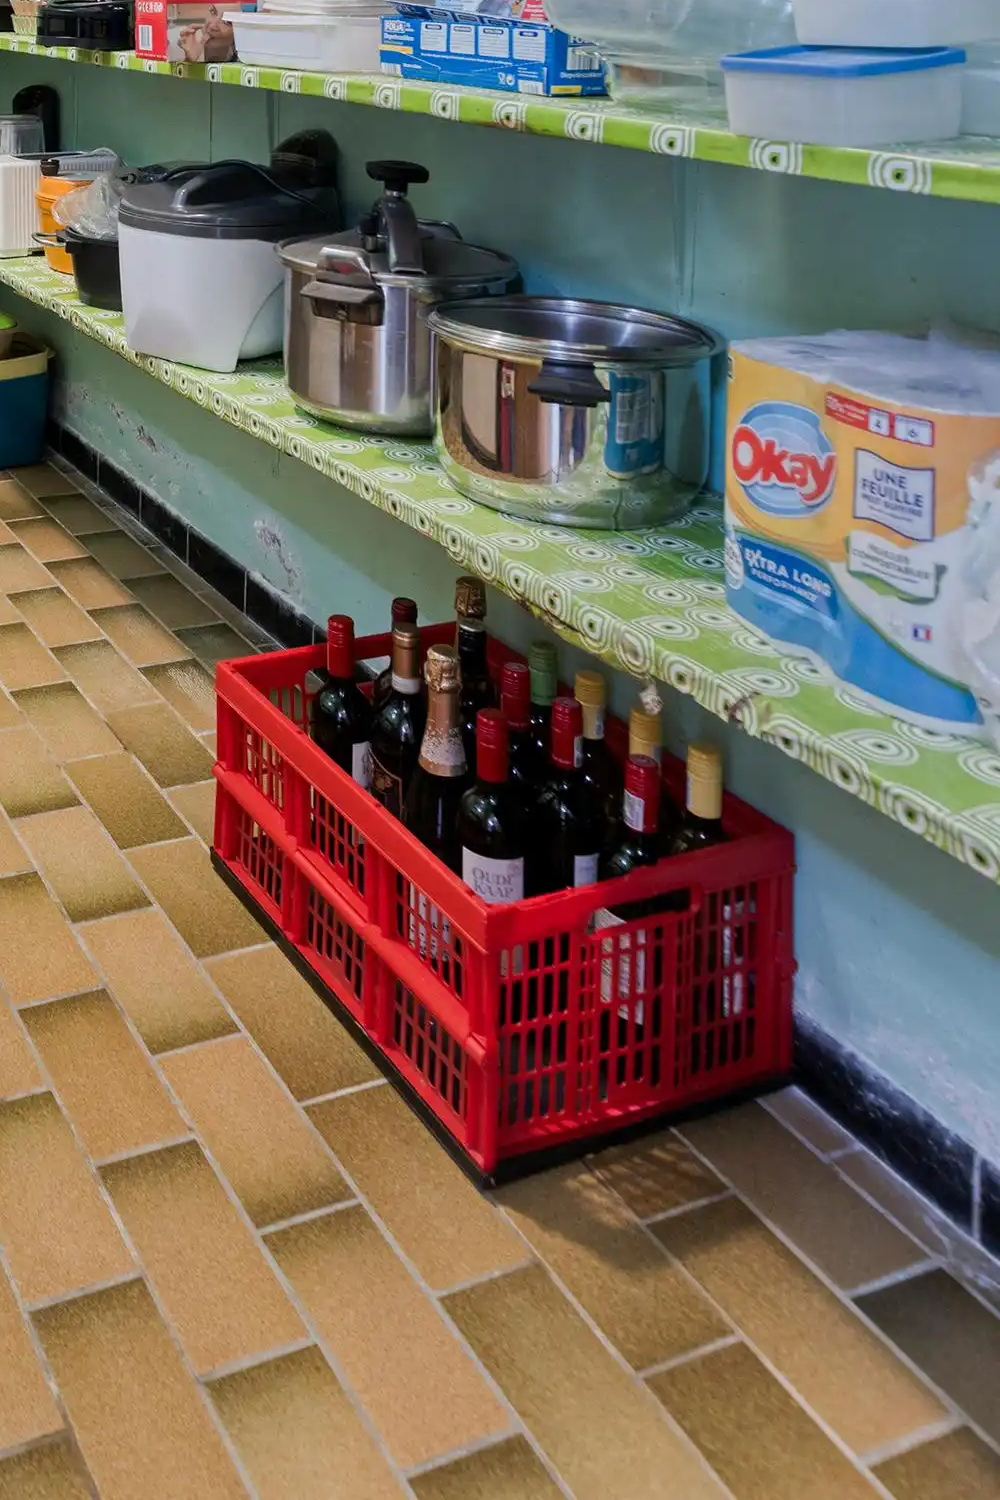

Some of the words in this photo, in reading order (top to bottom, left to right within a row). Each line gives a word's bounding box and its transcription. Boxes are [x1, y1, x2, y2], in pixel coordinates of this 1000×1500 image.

[731, 425, 836, 504] Okay
[873, 467, 907, 490] UNE
[861, 478, 924, 509] FEUILLE
[744, 547, 790, 579] EXTRA
[792, 568, 832, 598] LONG
